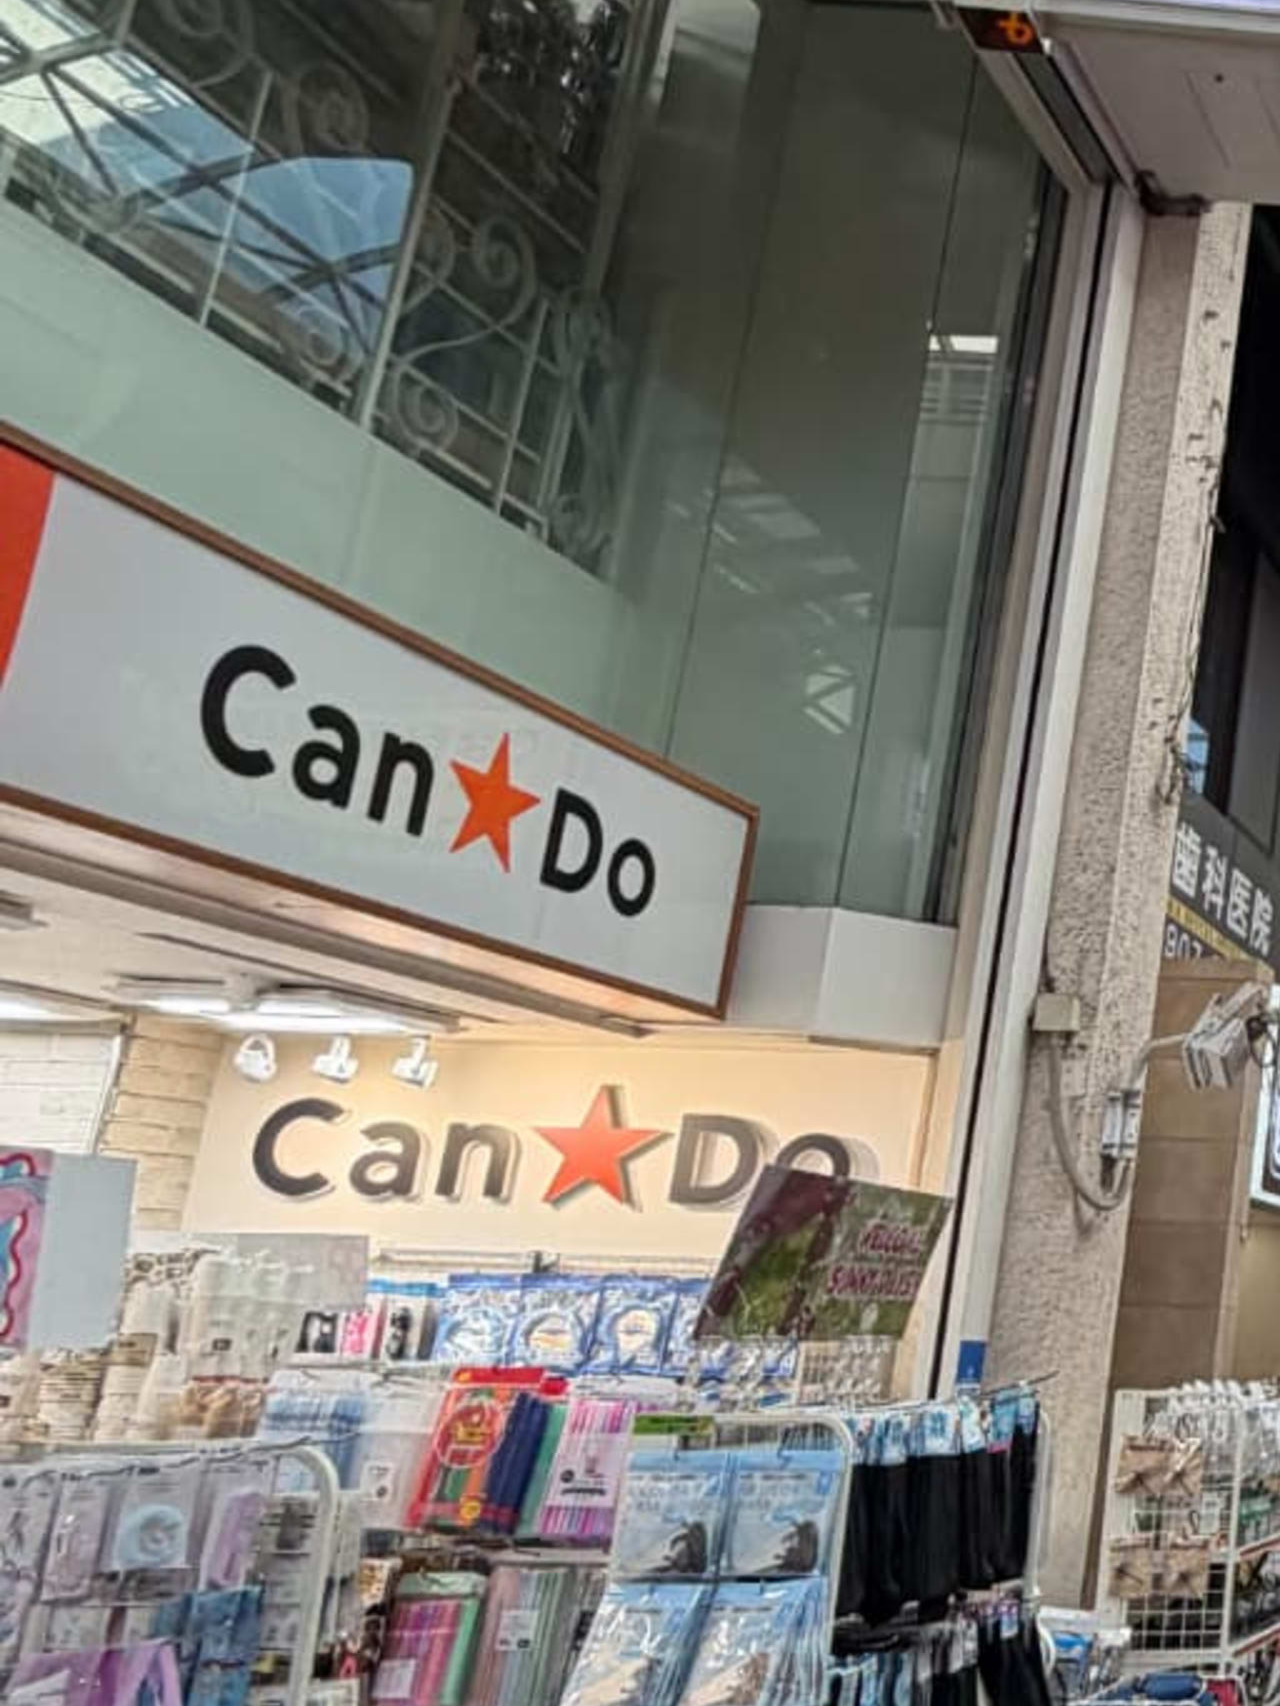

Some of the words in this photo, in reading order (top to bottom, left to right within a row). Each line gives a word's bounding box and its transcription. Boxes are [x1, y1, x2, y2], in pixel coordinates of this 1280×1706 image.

[200, 643, 435, 837] Can
[539, 787, 657, 918] Do
[1171, 821, 1275, 957] 歯科医院
[251, 1098, 517, 1200] Can
